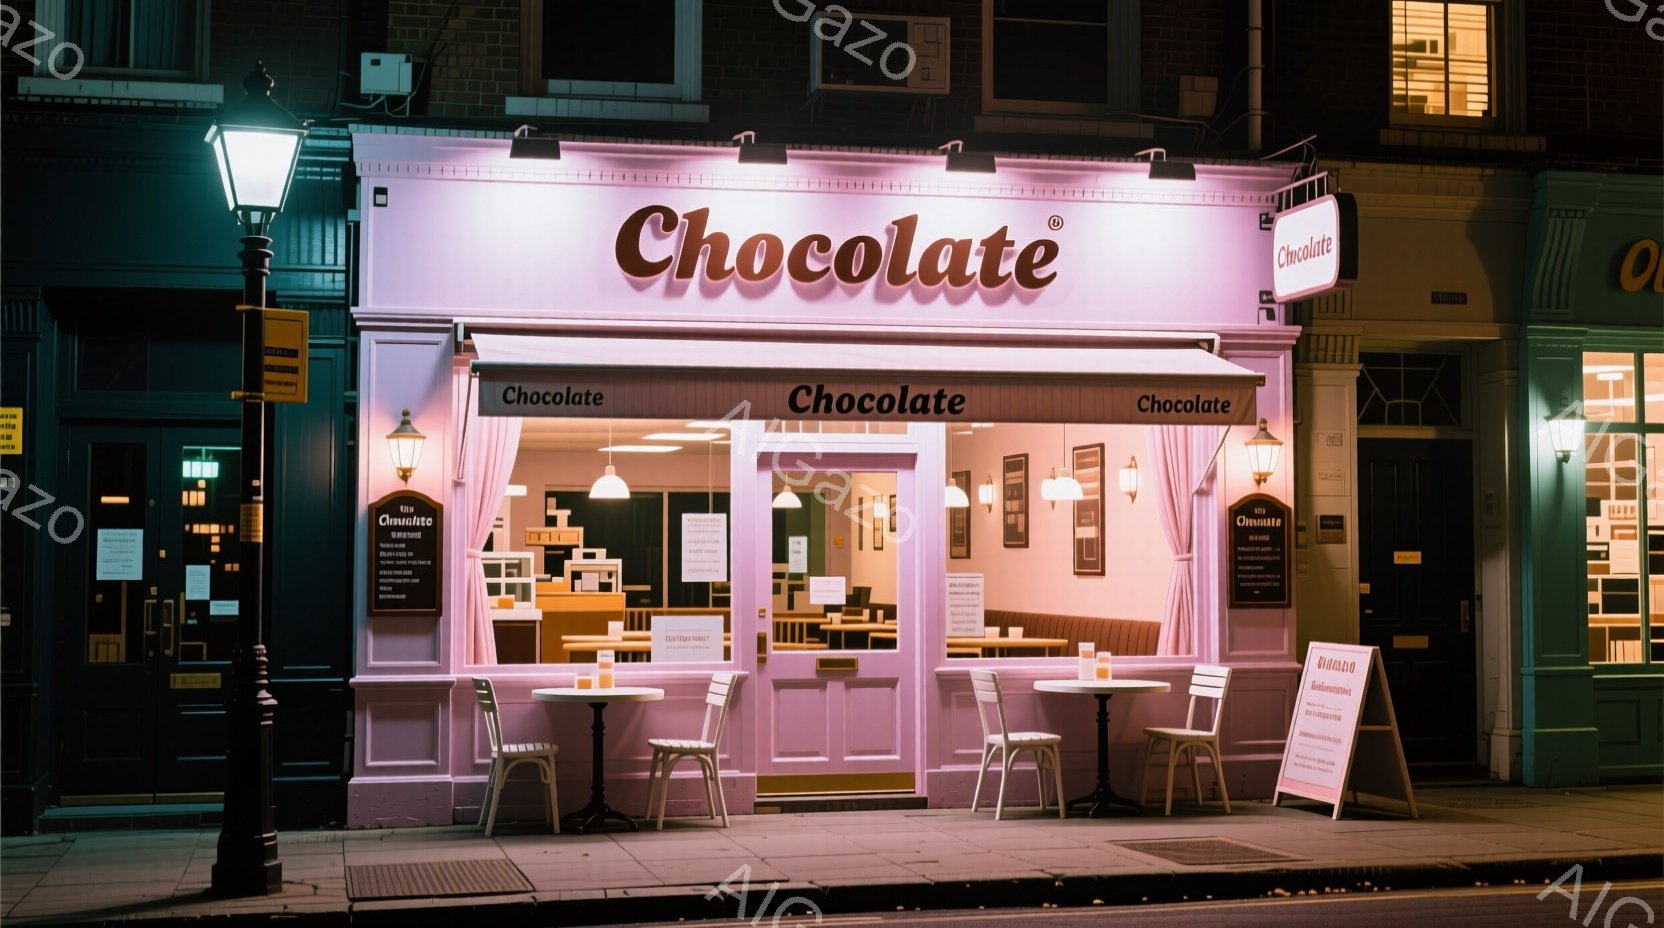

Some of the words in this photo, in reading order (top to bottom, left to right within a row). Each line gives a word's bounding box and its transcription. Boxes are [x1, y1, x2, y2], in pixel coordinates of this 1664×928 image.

[615, 204, 1060, 290] Chocolate
[502, 385, 604, 406] Chocolate
[788, 384, 966, 415] Chocolate
[1137, 394, 1231, 414] Chocolate
